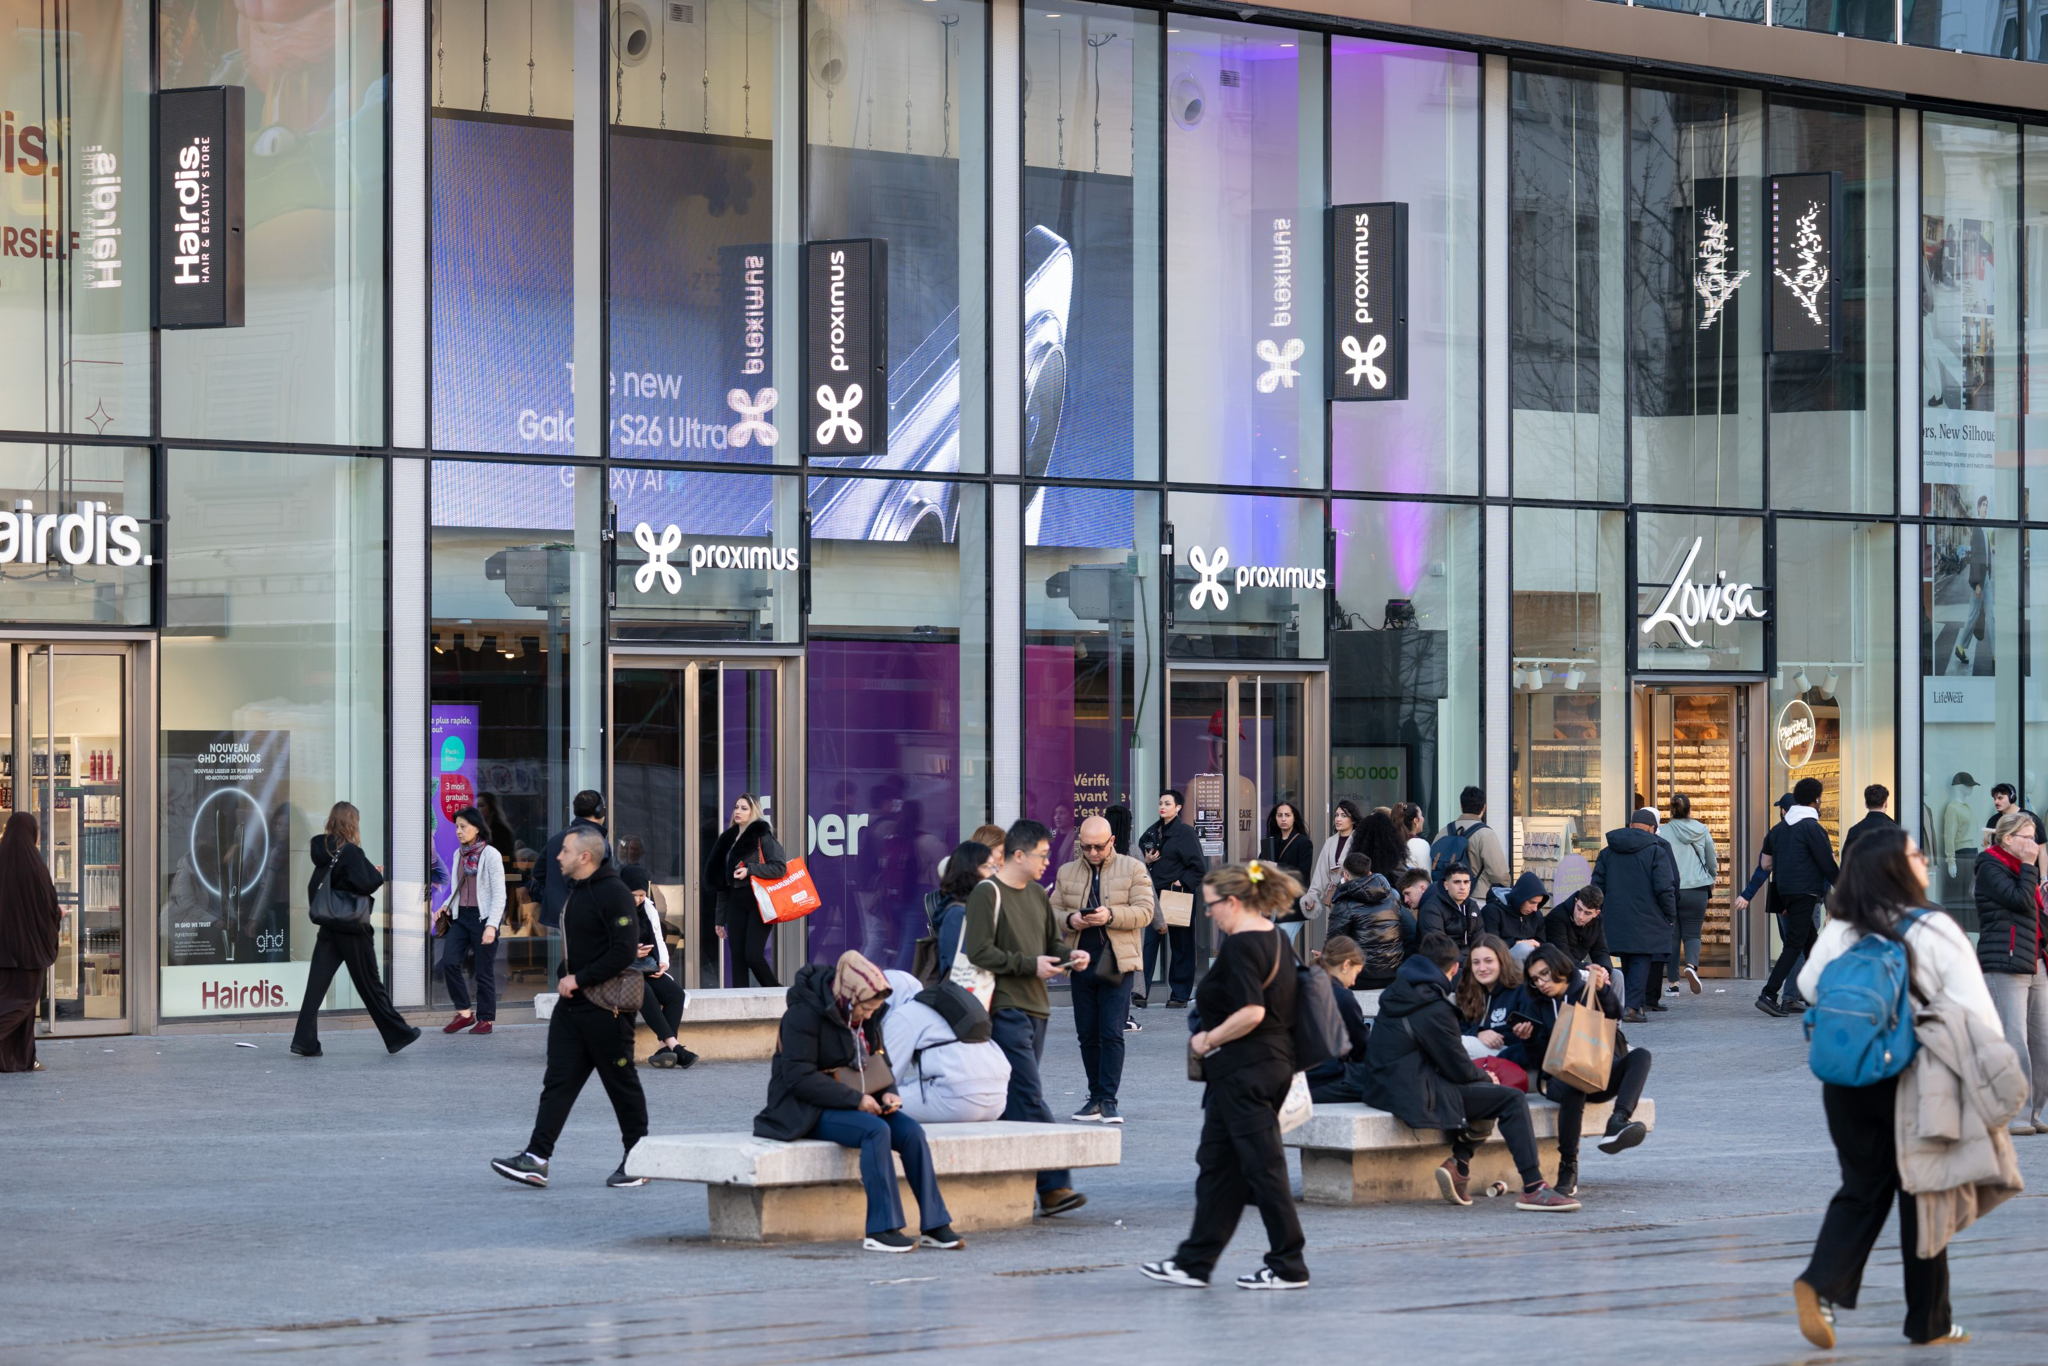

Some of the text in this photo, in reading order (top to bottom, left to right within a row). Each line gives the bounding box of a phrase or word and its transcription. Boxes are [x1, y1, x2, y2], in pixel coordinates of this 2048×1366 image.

[174, 137, 200, 284] Hairdis.
[201, 136, 210, 283] HAIR & BEAUTY STORE
[0, 226, 80, 260] RSELF
[1355, 213, 1373, 323] proximus
[831, 250, 849, 371] proximus
[623, 371, 683, 399] new
[619, 414, 663, 447] S26
[669, 416, 728, 449] Ultra
[1939, 424, 1960, 440] New
[690, 544, 800, 576] proximus
[1236, 565, 1327, 595] proximus
[1641, 536, 1768, 648] Lovisa
[1933, 691, 1964, 704] LifeWear
[197, 753, 262, 764] GHD CHRONOS
[209, 743, 250, 753] NOUVEAU
[445, 782, 465, 790] 3 mois
[1073, 790, 1108, 802] avant
[256, 928, 284, 953] ghd
[202, 979, 289, 1010] Hairdis.
